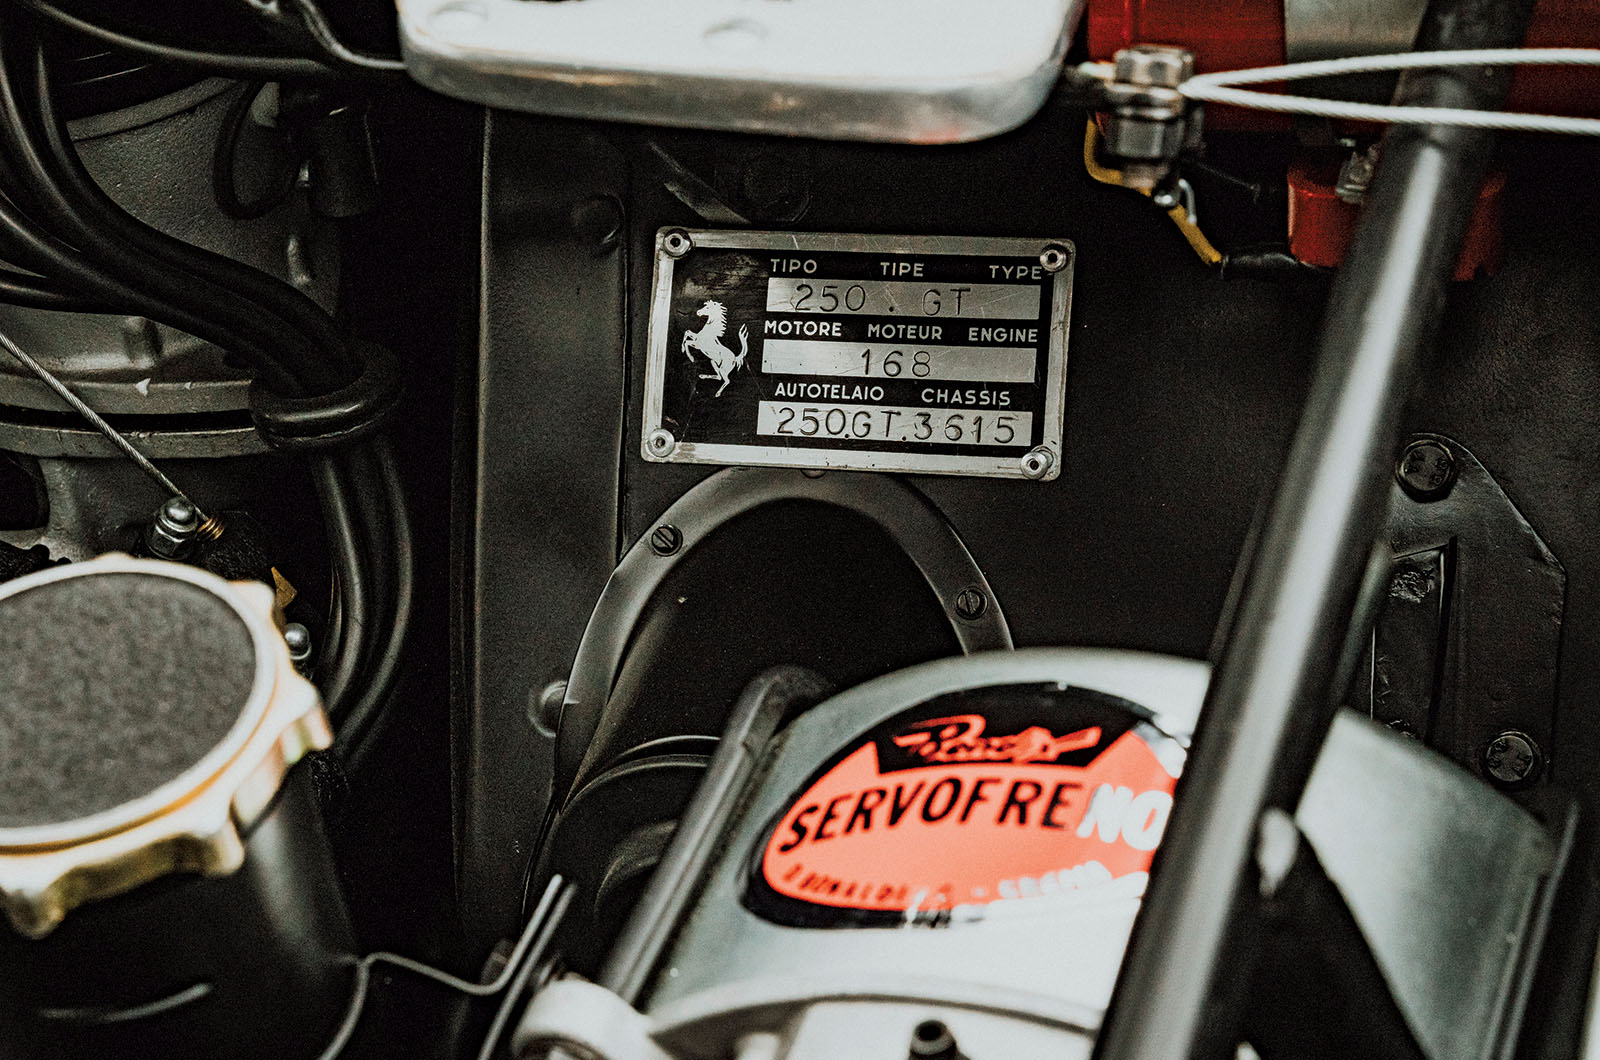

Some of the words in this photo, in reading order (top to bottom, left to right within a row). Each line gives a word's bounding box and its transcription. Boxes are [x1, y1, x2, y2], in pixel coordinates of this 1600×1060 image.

[770, 258, 818, 274] TIPO
[880, 262, 924, 277] TIPE
[989, 265, 1042, 280] TYPE
[794, 284, 866, 311] 250
[922, 288, 971, 316] GT
[764, 320, 842, 336] MOTORE
[868, 324, 942, 340] MOTEUR
[968, 327, 1038, 342] ENGINE
[861, 349, 931, 377] 168
[774, 382, 884, 400] AUTOTELAIO
[921, 388, 1011, 405] CHASSIS
